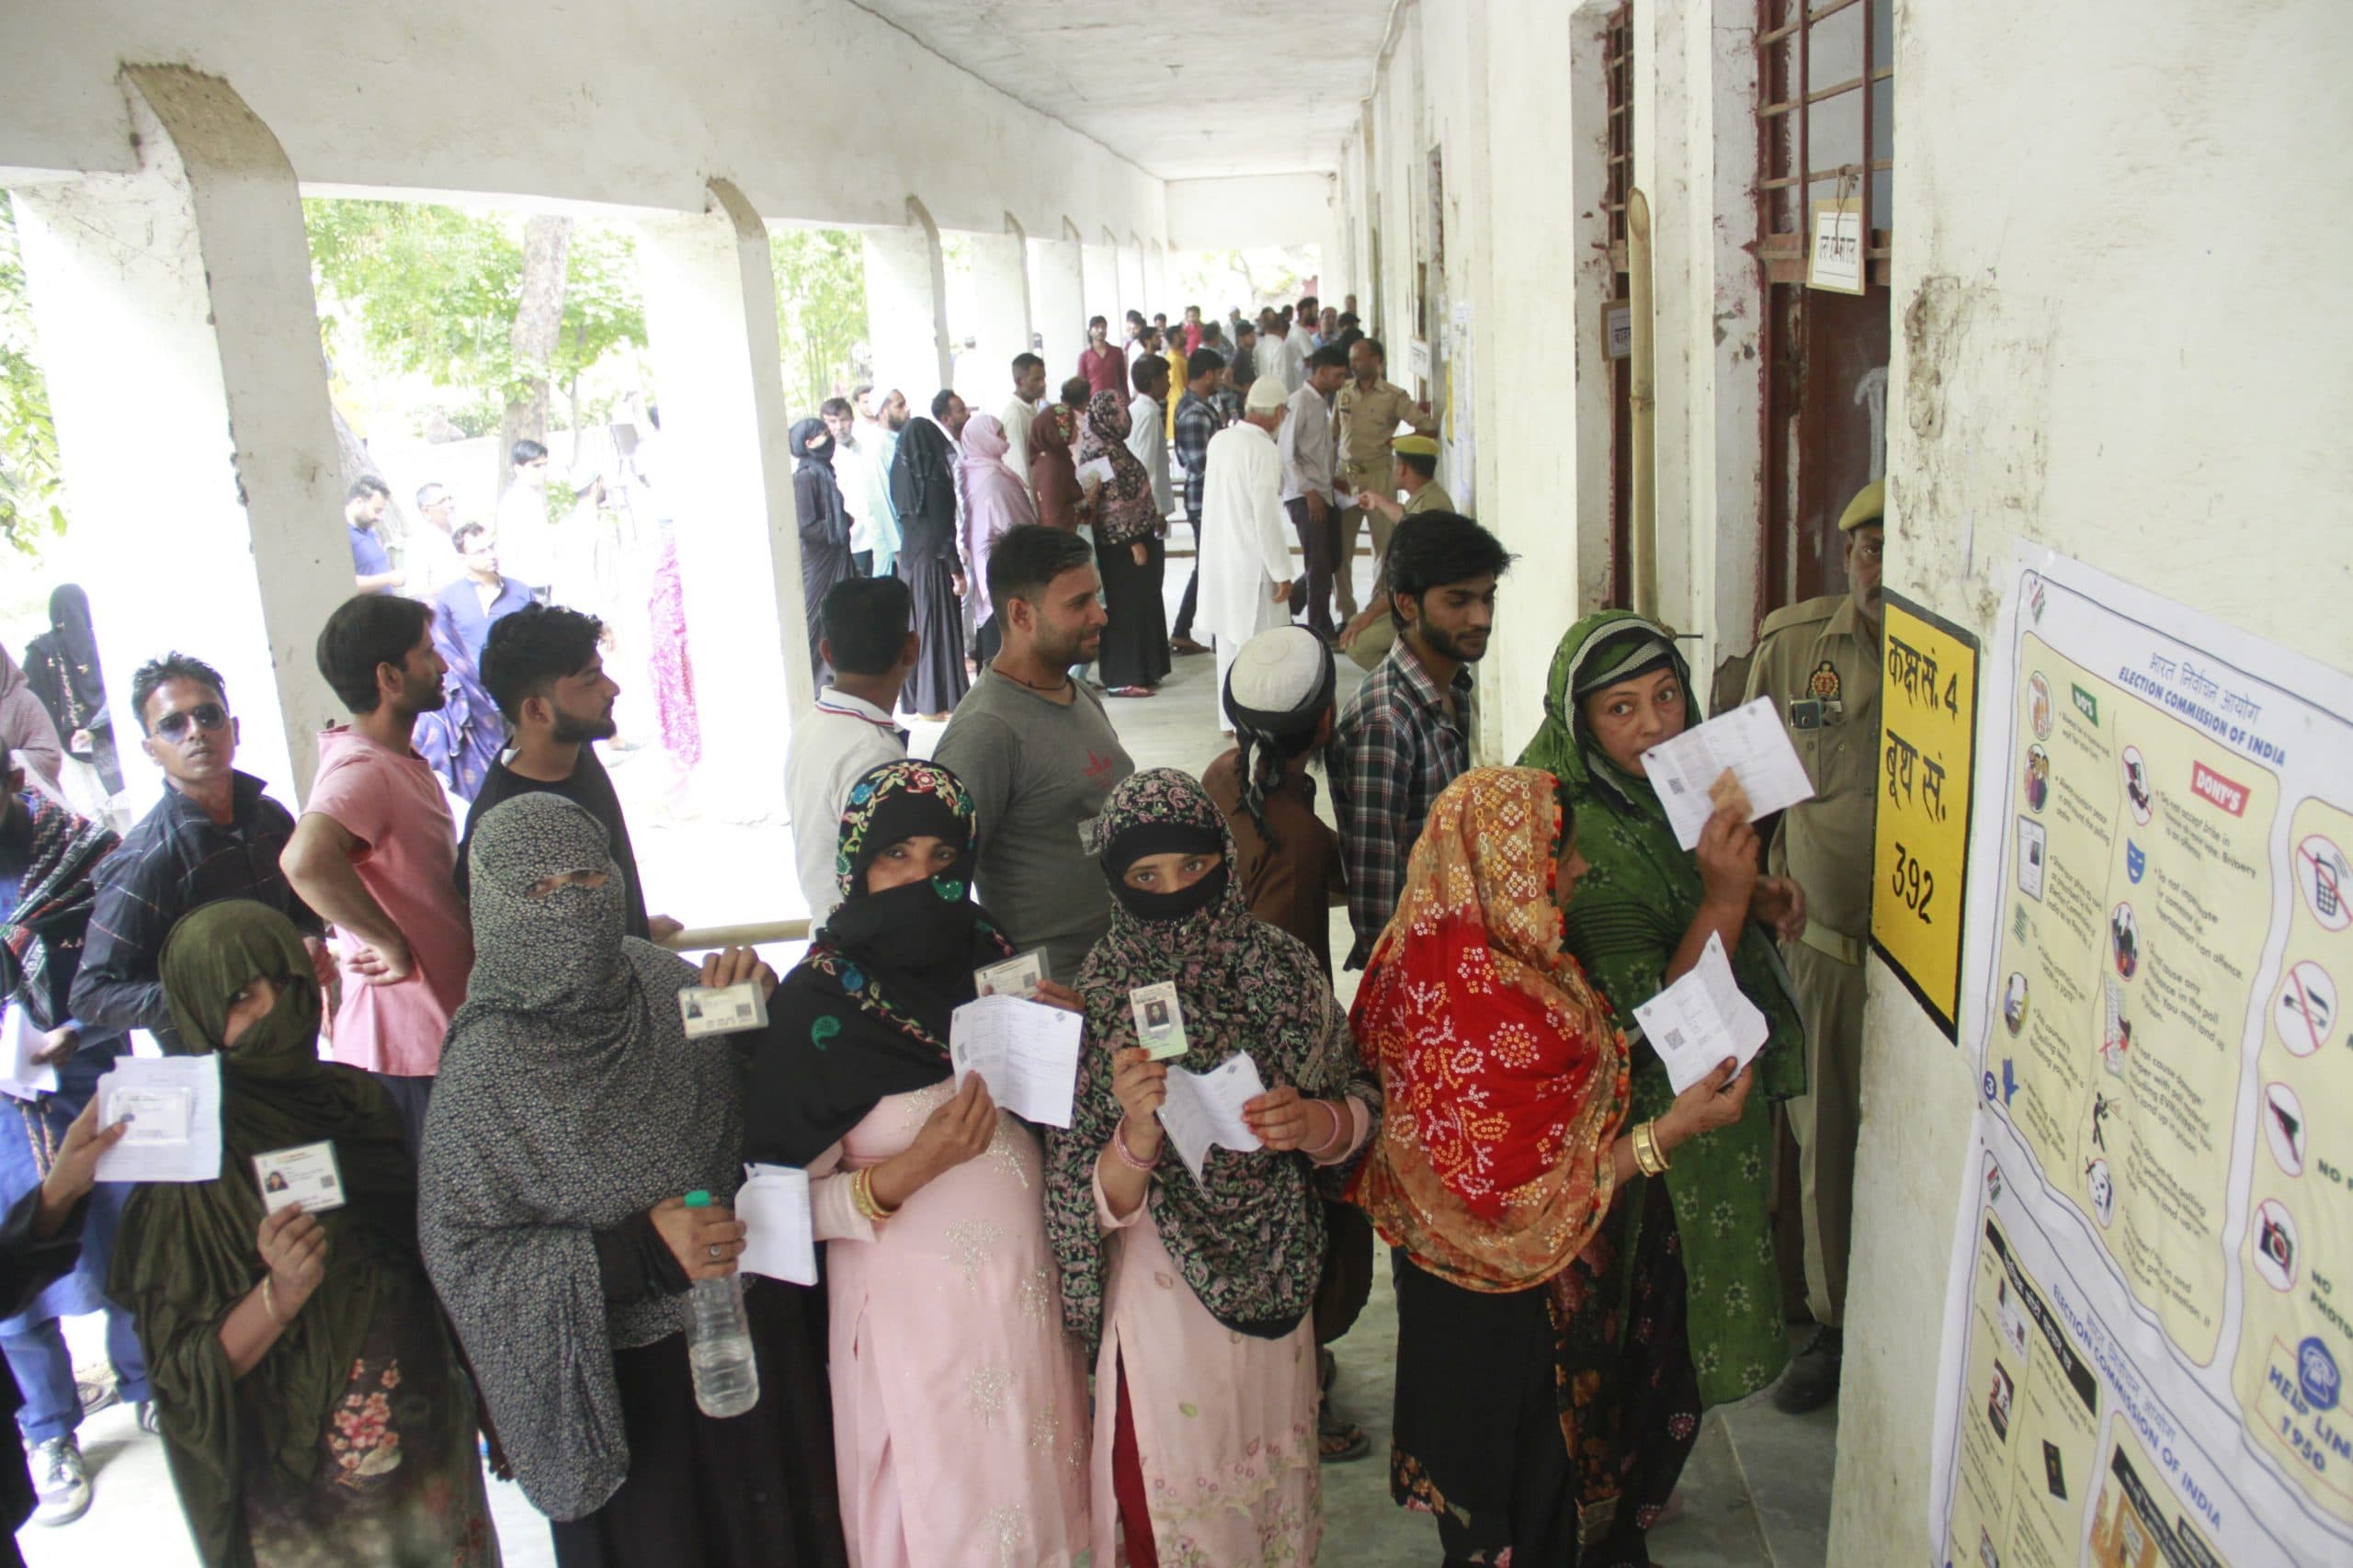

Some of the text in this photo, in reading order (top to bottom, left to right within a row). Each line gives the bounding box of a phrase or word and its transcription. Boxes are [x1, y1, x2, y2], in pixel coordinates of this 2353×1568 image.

[1944, 672, 1958, 724] 4
[2150, 653, 2177, 682] भारत
[2220, 690, 2262, 725] आयोग
[2118, 666, 2286, 767] ELECTION COMMISSION OF INDIA
[1886, 728, 1918, 811] बूथ
[1923, 751, 1947, 824] सं.
[2222, 833, 2231, 847] in
[1893, 841, 1933, 925] 392
[2188, 996, 2202, 1012] the
[2201, 1008, 2219, 1026] poll
[2197, 1020, 2216, 1042] land
[2153, 1058, 2176, 1079] cause
[2318, 1157, 2342, 1185] NO
[2312, 1268, 2333, 1295] NO
[2053, 1283, 2093, 1351] ELECTION
[2094, 1346, 2159, 1450] COMMISSION
[2161, 1447, 2180, 1472] OF
[2181, 1472, 2221, 1533] INDIA
[2268, 1364, 2353, 1464] HELP LIN
[2281, 1415, 2327, 1472] 1950
